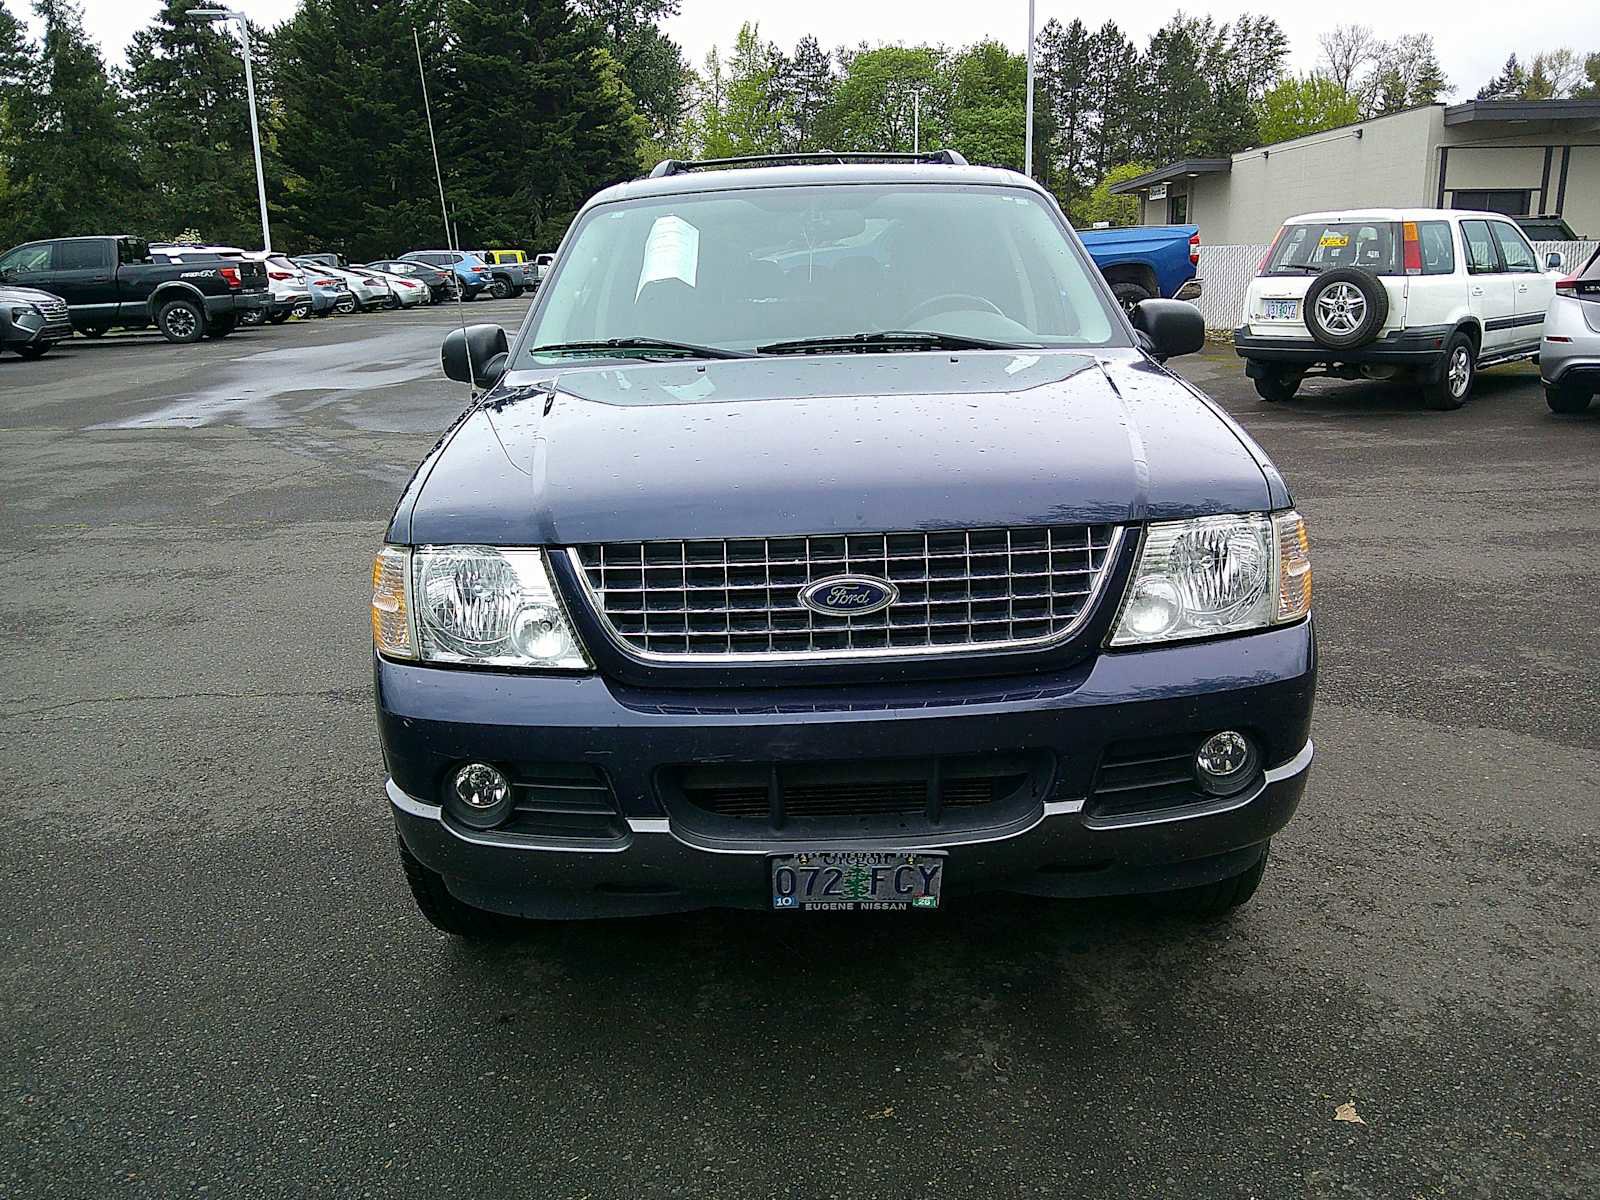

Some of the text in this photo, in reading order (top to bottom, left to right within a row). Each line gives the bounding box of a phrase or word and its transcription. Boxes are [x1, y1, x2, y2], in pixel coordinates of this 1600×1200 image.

[826, 585, 870, 606] Ford
[776, 864, 941, 896] 072 FCY
[776, 896, 792, 907] 10
[805, 903, 907, 911] EUGENE NISSAN
